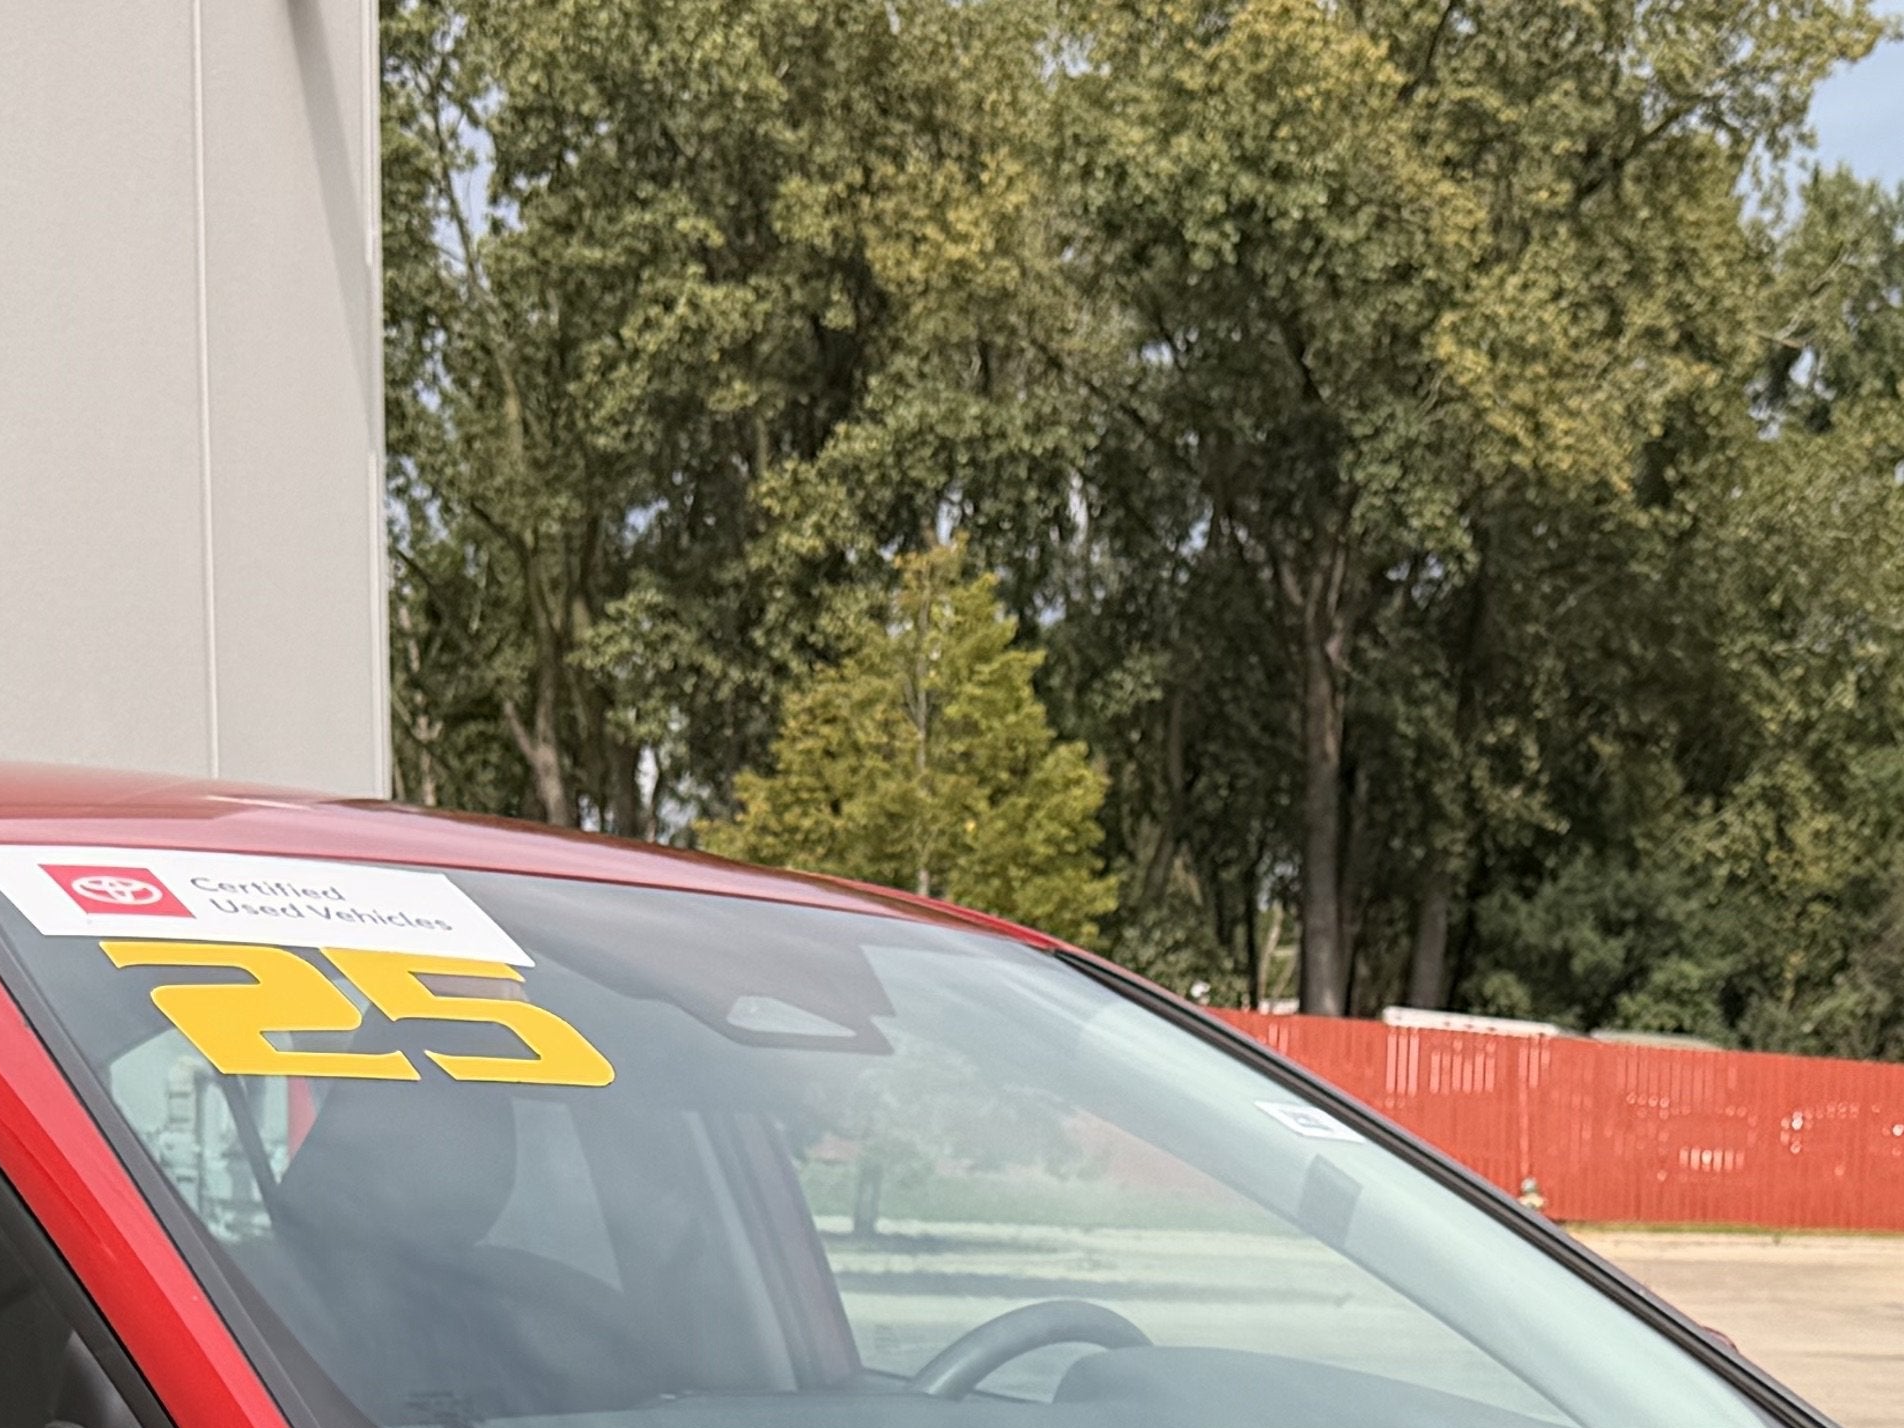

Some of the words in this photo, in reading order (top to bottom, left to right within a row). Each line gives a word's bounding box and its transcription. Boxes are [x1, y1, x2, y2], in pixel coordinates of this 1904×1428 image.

[190, 876, 346, 901] Certified
[209, 898, 305, 920] Used
[306, 904, 453, 931] Vehicles
[99, 940, 616, 1087] 25
